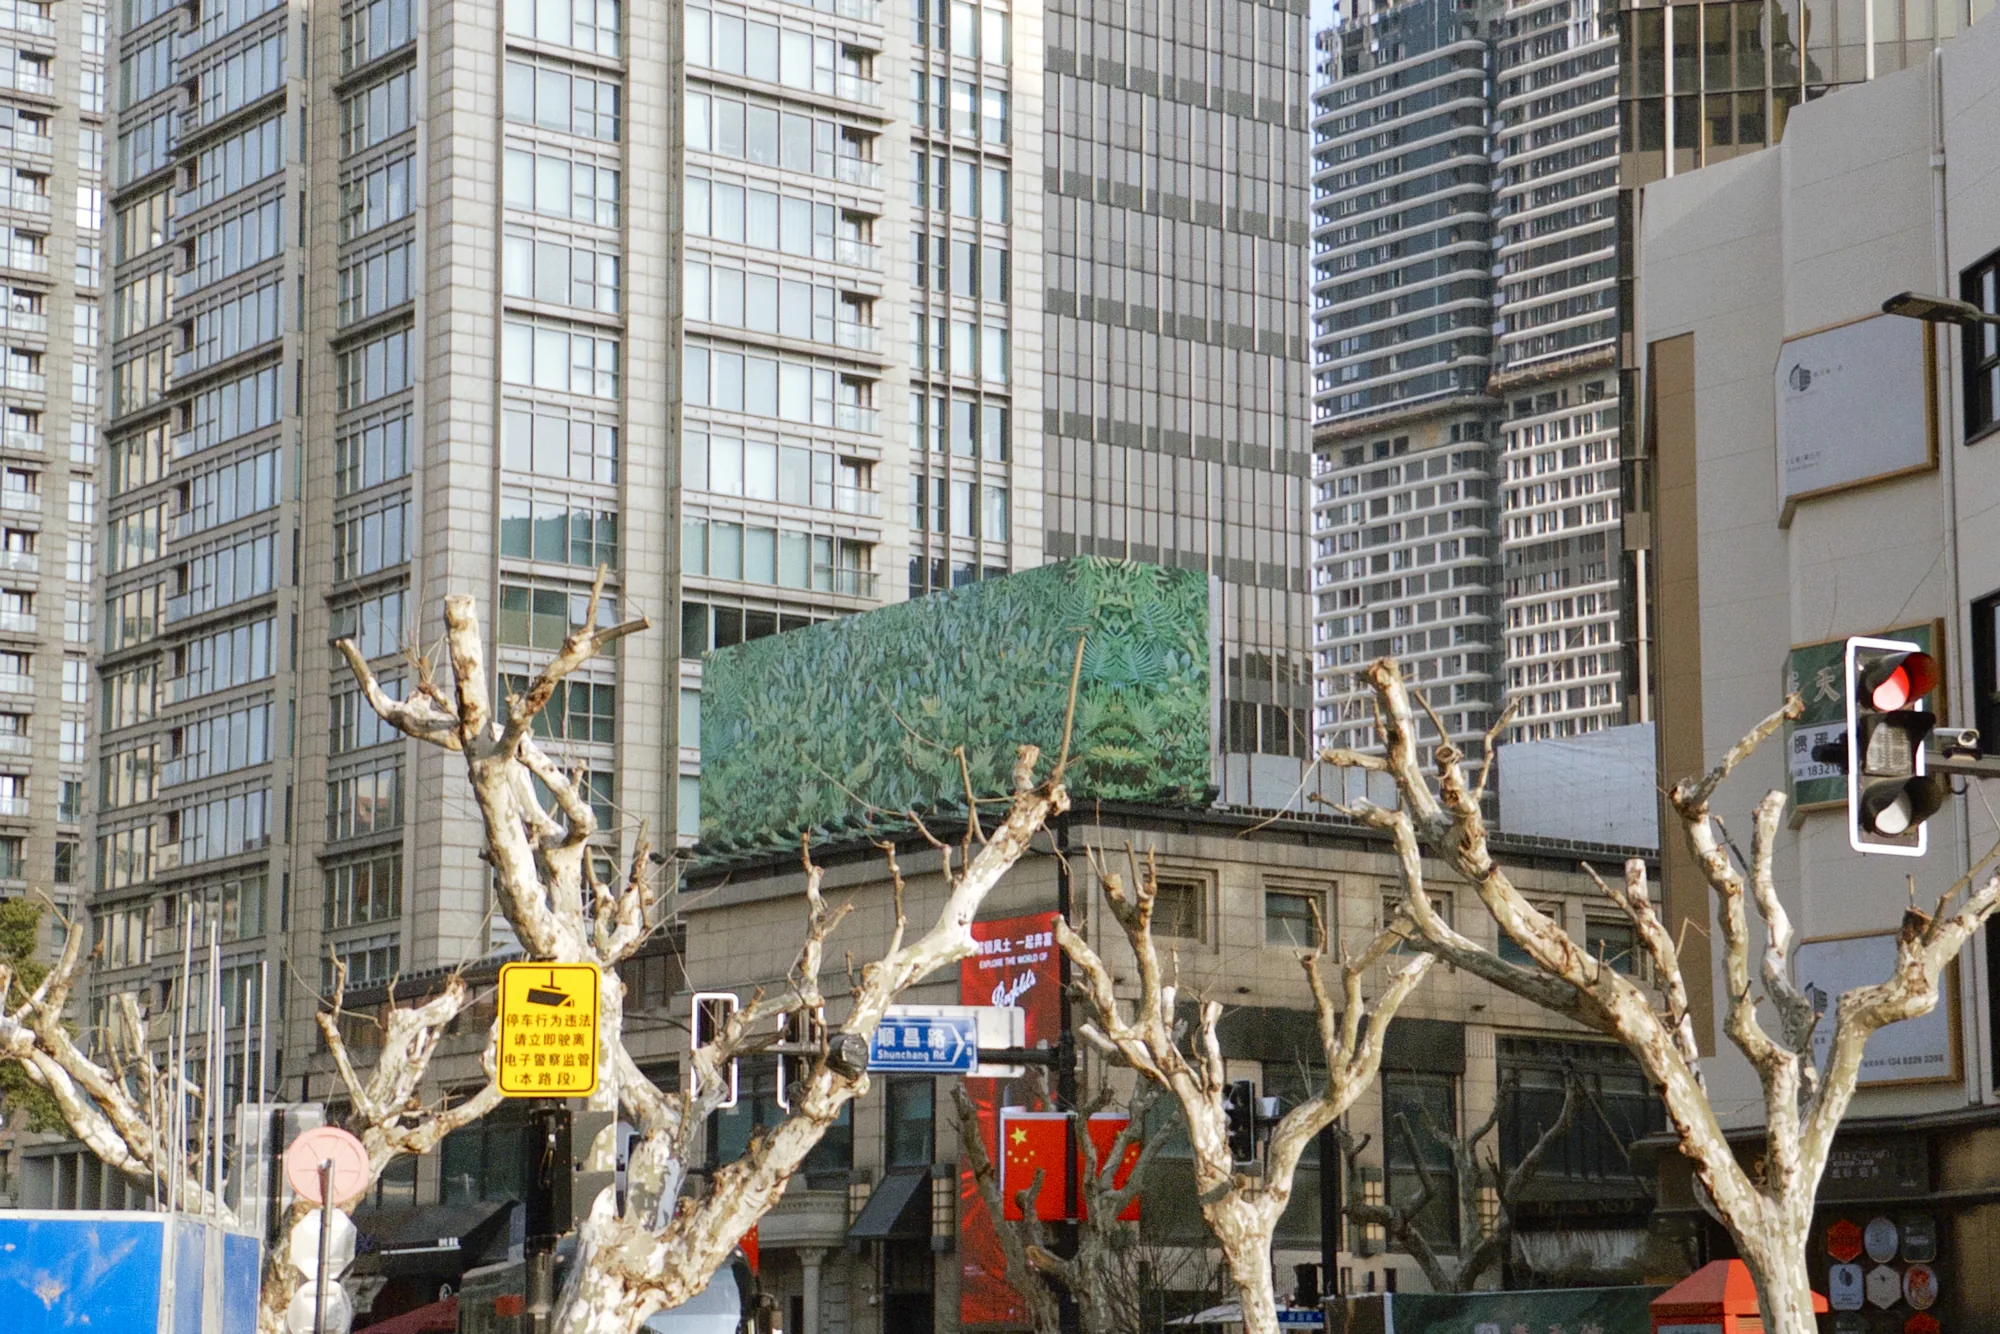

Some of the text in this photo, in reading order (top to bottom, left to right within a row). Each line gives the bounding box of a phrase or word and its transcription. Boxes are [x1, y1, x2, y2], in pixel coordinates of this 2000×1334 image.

[506, 1013, 592, 1028] 停车行为违法
[514, 1033, 585, 1047] 请立即驶离
[877, 1027, 946, 1049] 顺昌路
[504, 1053, 591, 1067] 电子警察监管
[877, 1049, 929, 1063] Shunchang
